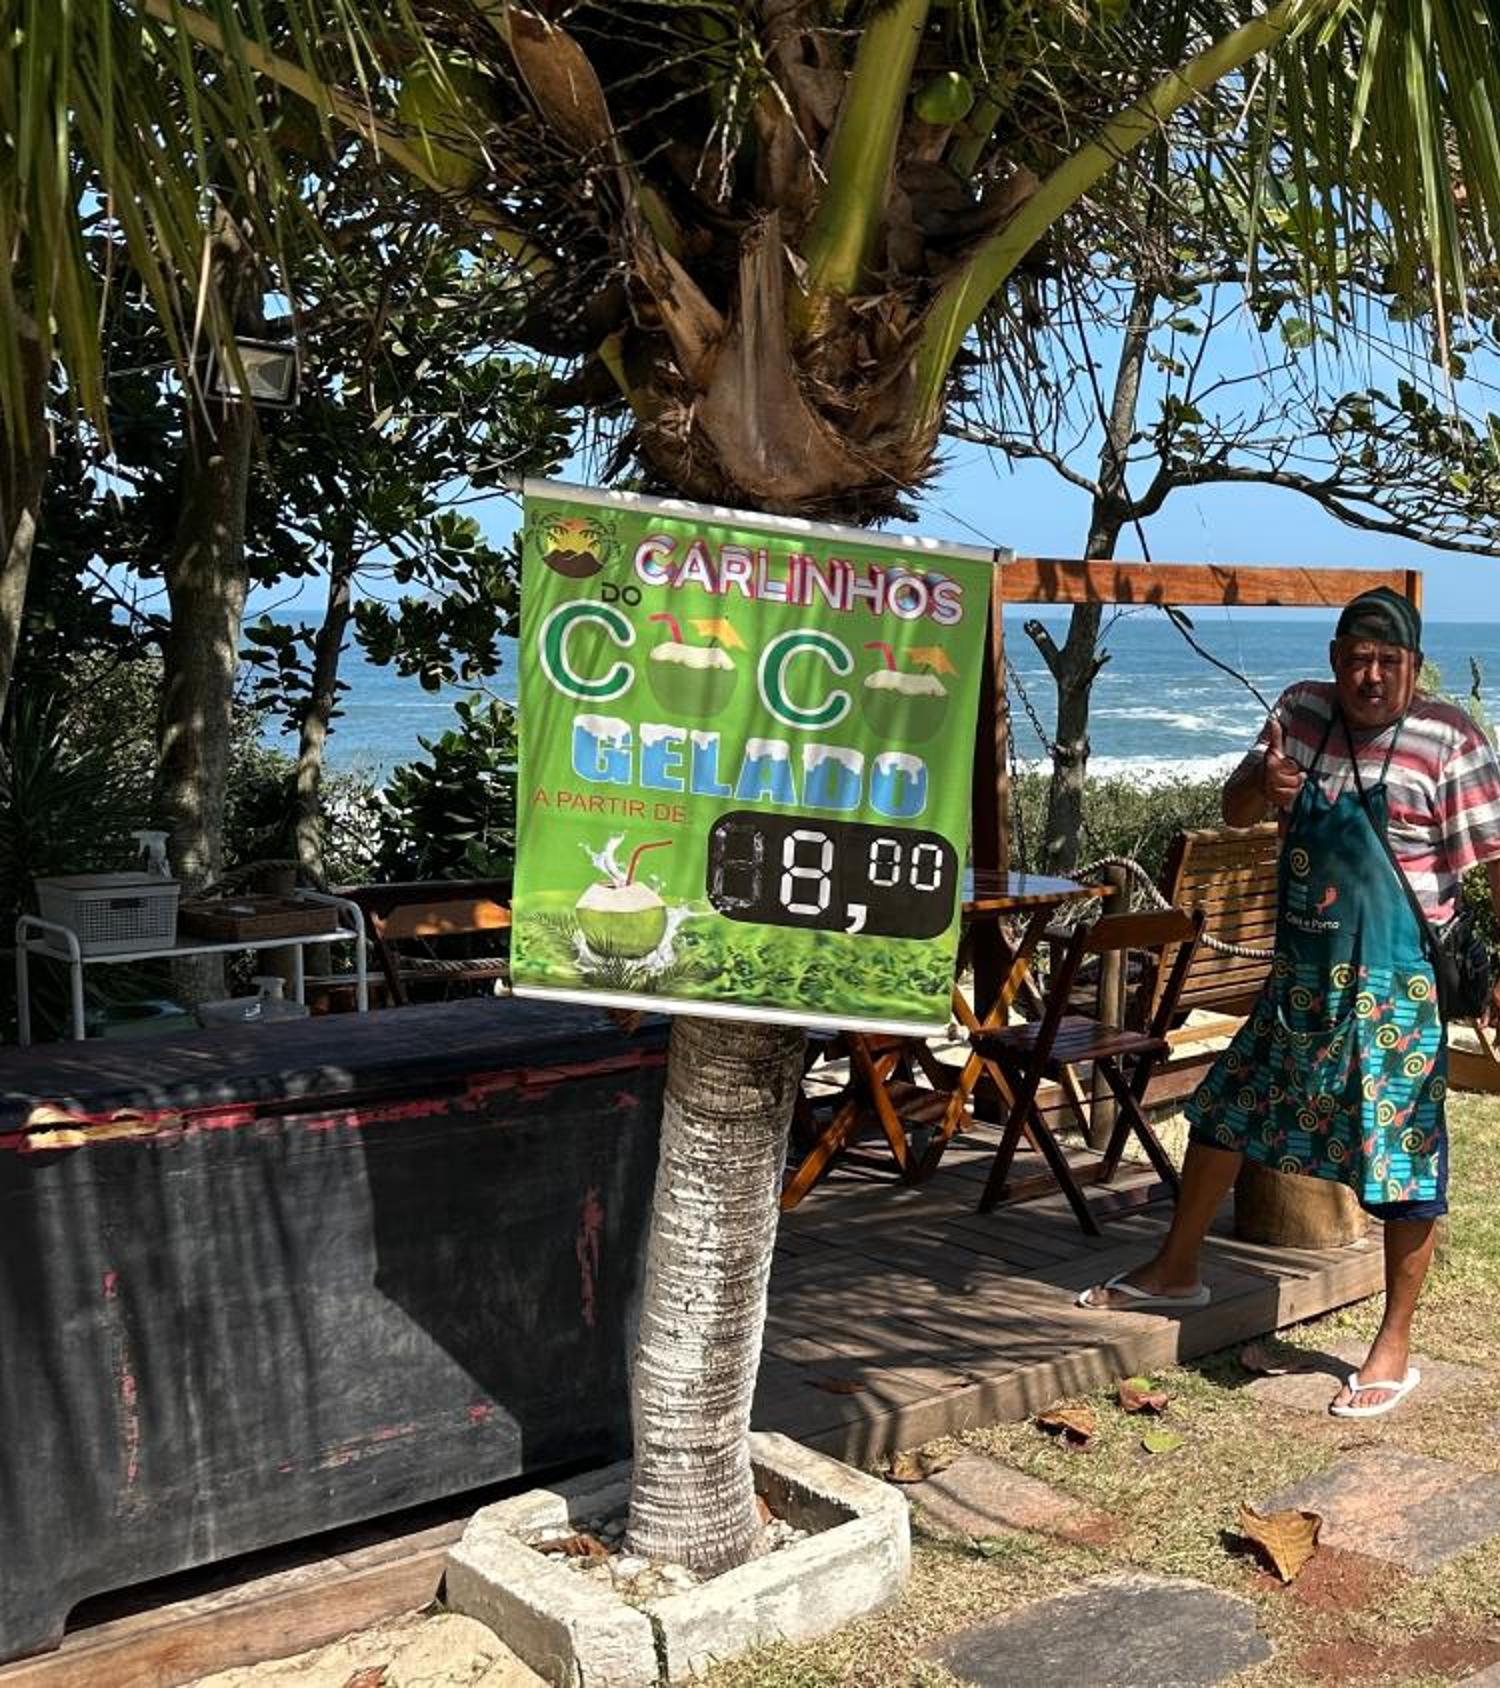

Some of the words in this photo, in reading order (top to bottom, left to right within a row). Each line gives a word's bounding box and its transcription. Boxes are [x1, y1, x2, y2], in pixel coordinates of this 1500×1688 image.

[601, 582, 642, 608] DO
[634, 534, 963, 625] CARLINHOS
[571, 714, 930, 819] GELADO
[533, 785, 549, 809] A
[557, 790, 646, 819] PARTIR
[654, 803, 687, 823] DE
